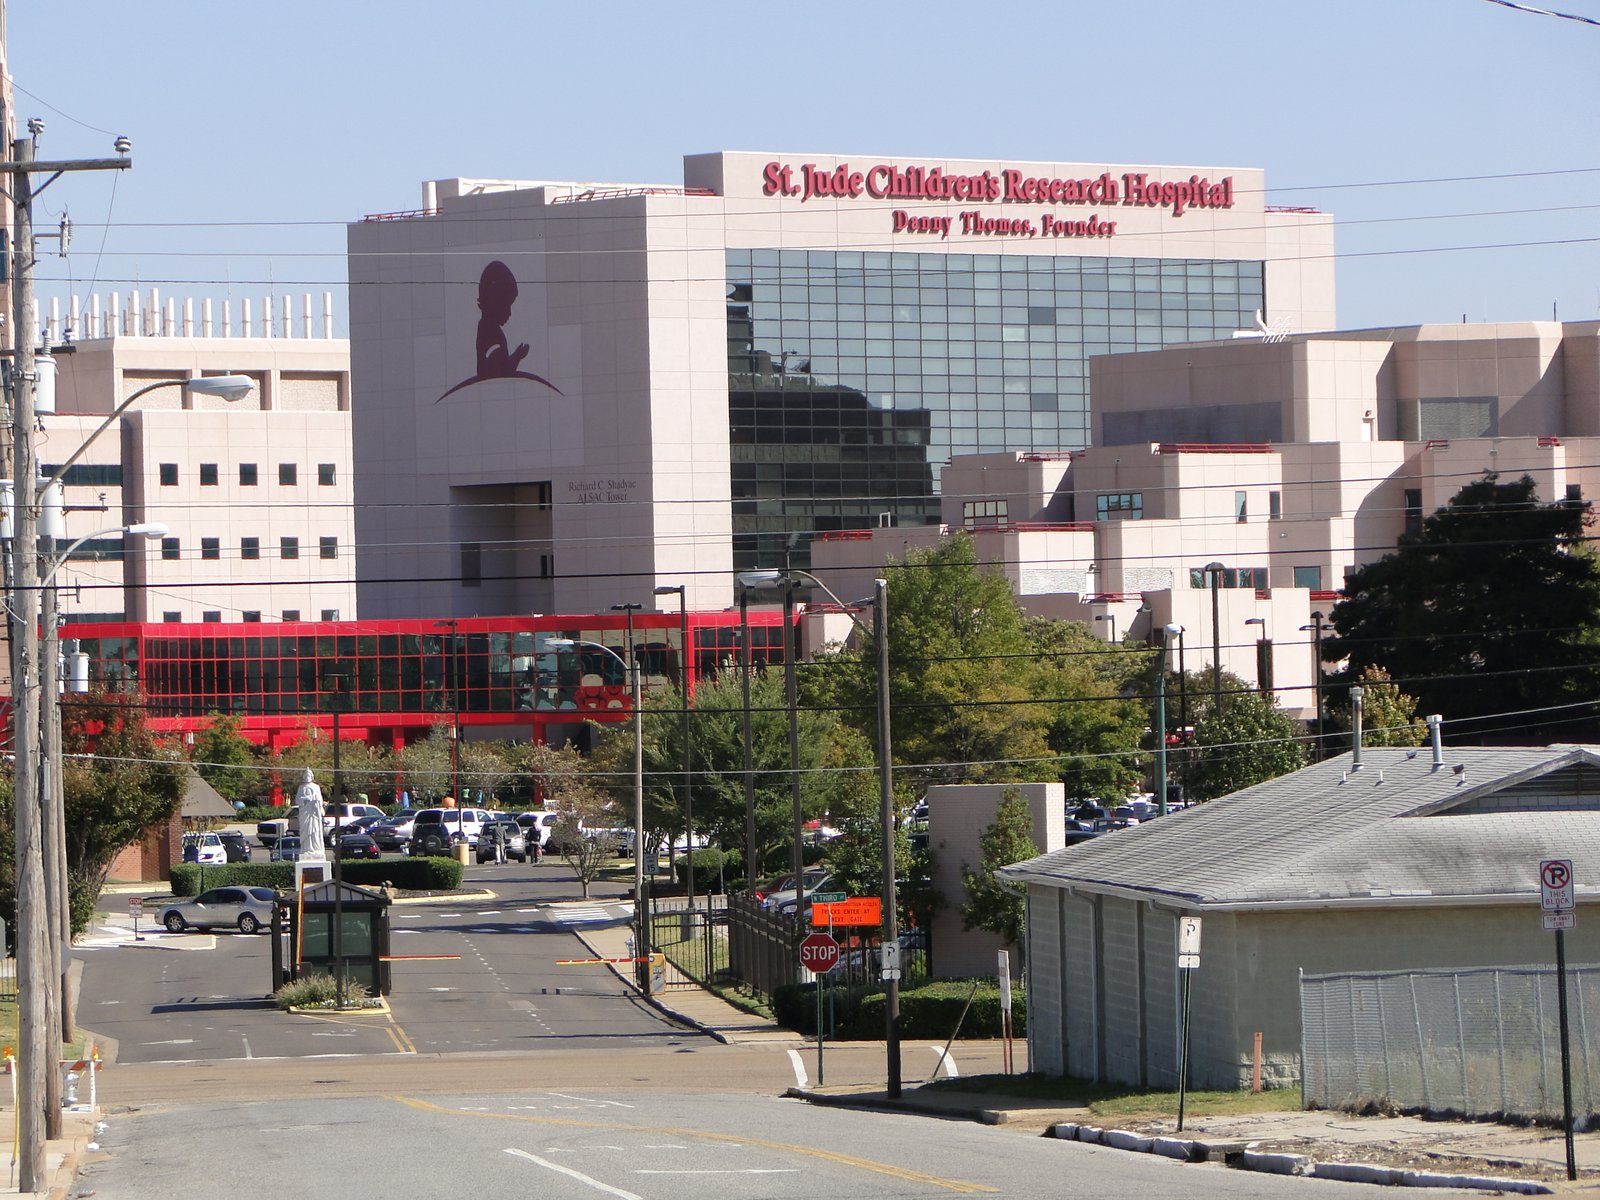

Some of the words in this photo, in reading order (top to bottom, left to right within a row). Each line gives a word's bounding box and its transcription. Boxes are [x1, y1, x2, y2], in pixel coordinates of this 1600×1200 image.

[763, 162, 800, 197] St.
[801, 163, 864, 202] Jude
[866, 164, 1000, 201] Children's
[1002, 169, 1121, 205] Research
[1122, 173, 1235, 217] Hospital
[892, 210, 953, 239] Danny
[960, 211, 1037, 238] Thomas,
[1041, 213, 1117, 238] Founder
[568, 481, 597, 491] Richard
[802, 945, 837, 961] STOP
